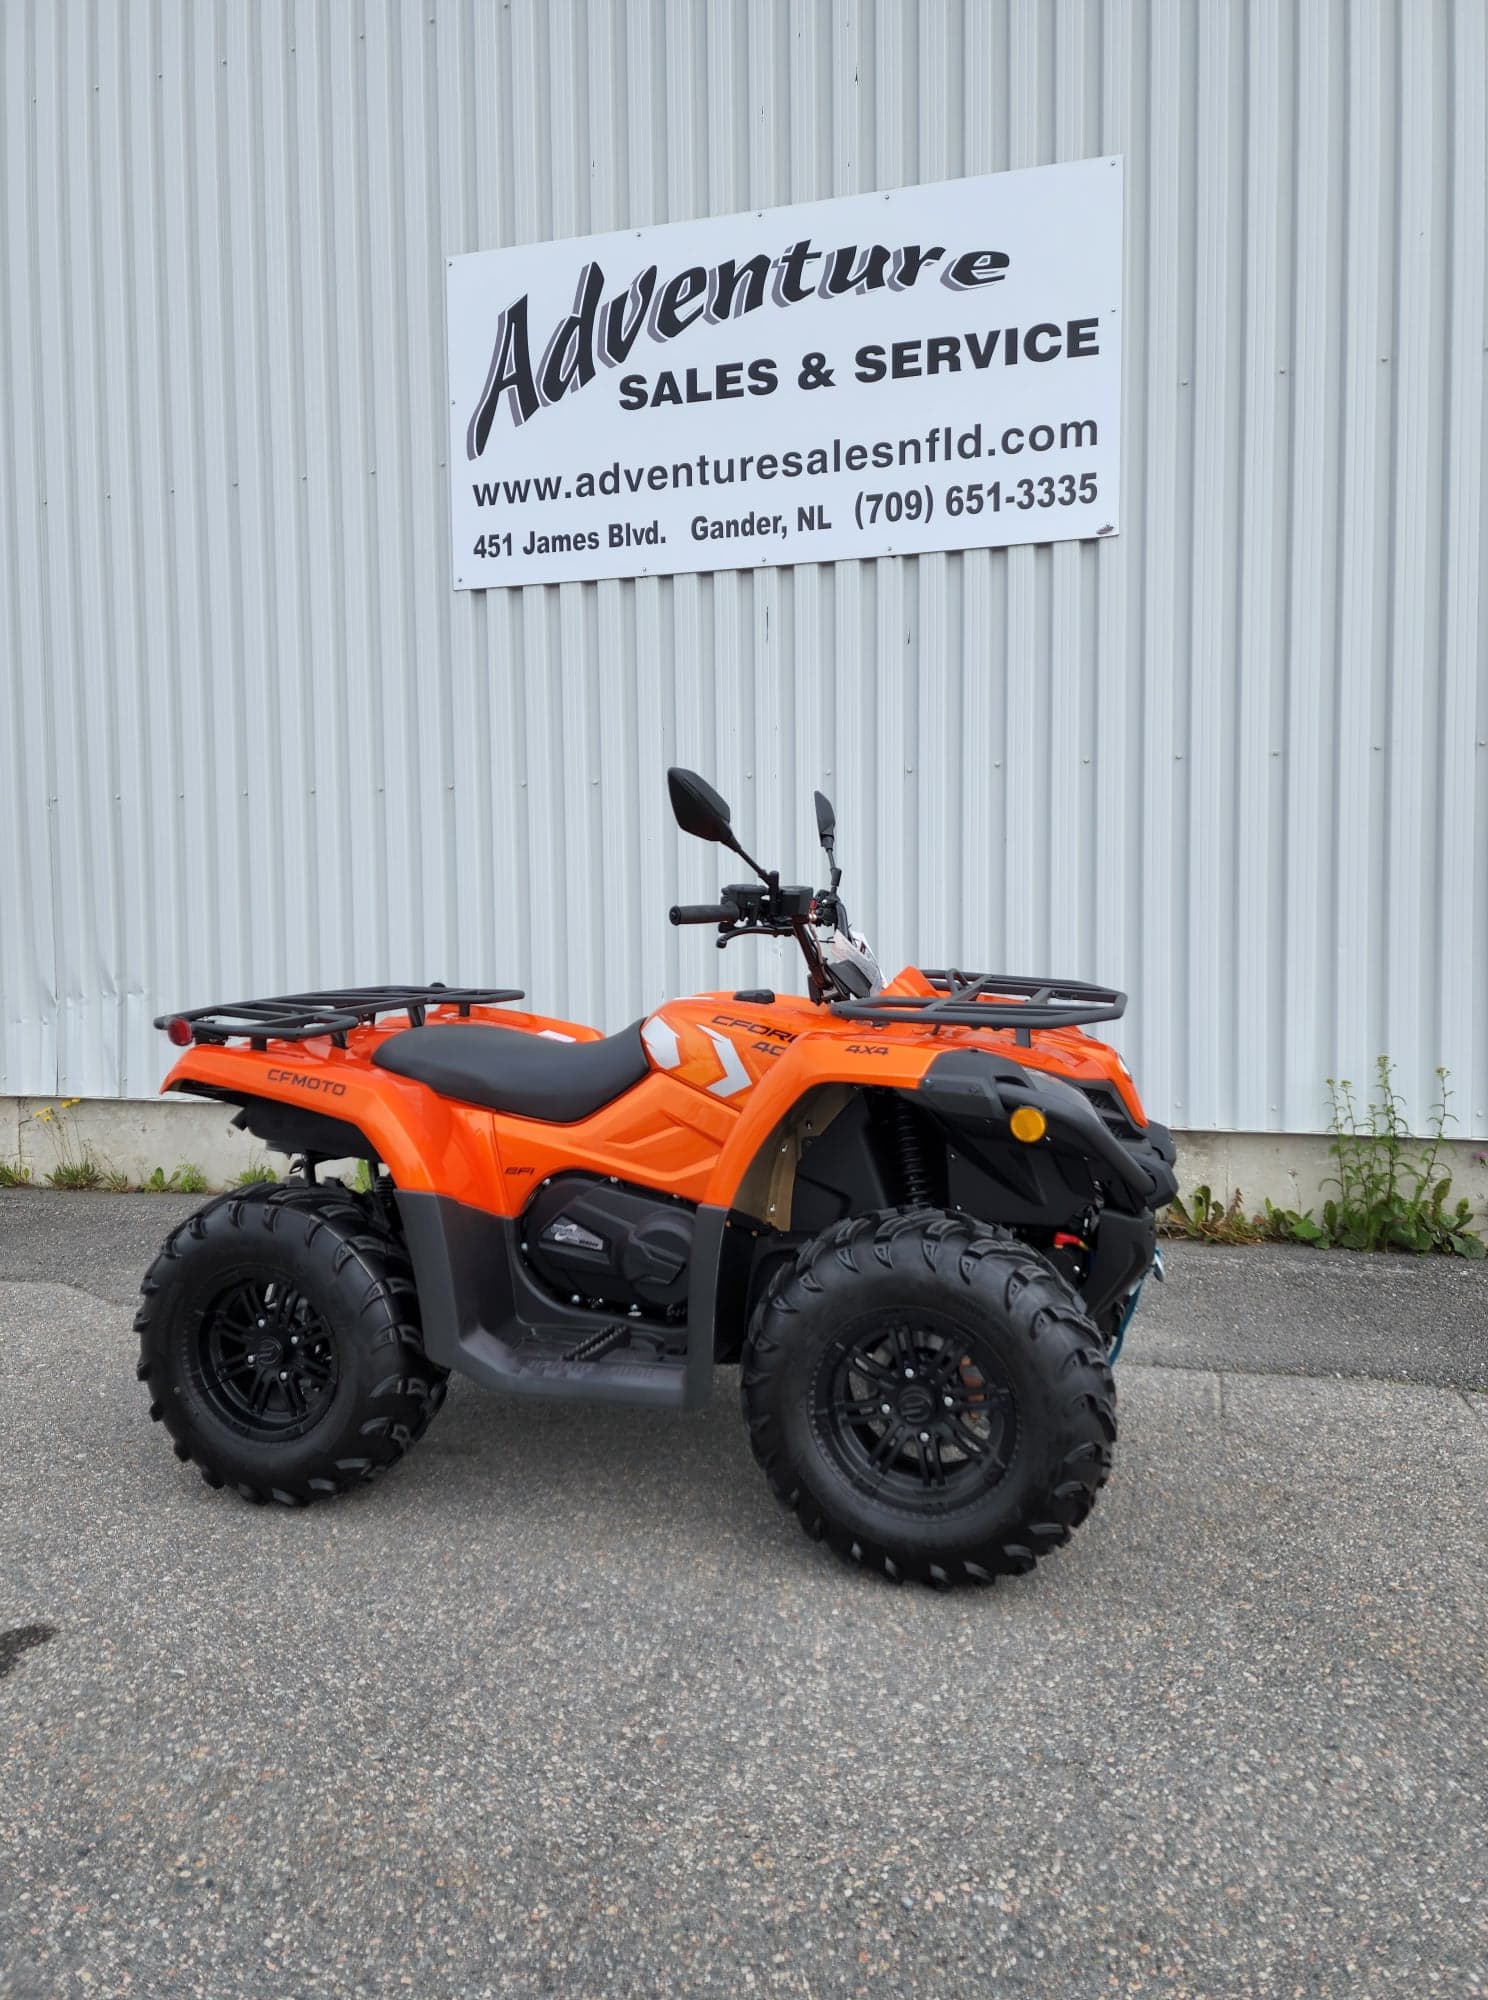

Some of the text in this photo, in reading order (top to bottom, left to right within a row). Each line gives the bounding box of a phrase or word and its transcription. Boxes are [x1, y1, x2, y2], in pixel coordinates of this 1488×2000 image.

[467, 238, 1010, 461] Adventure
[619, 317, 1100, 411] SALES & SERVICE
[472, 419, 1098, 508] www.adventuresalesnfld.com
[472, 472, 1098, 559] 451 James Blvd. Gander, NL (709) 651-3335
[267, 1068, 346, 1096] CFMOTO
